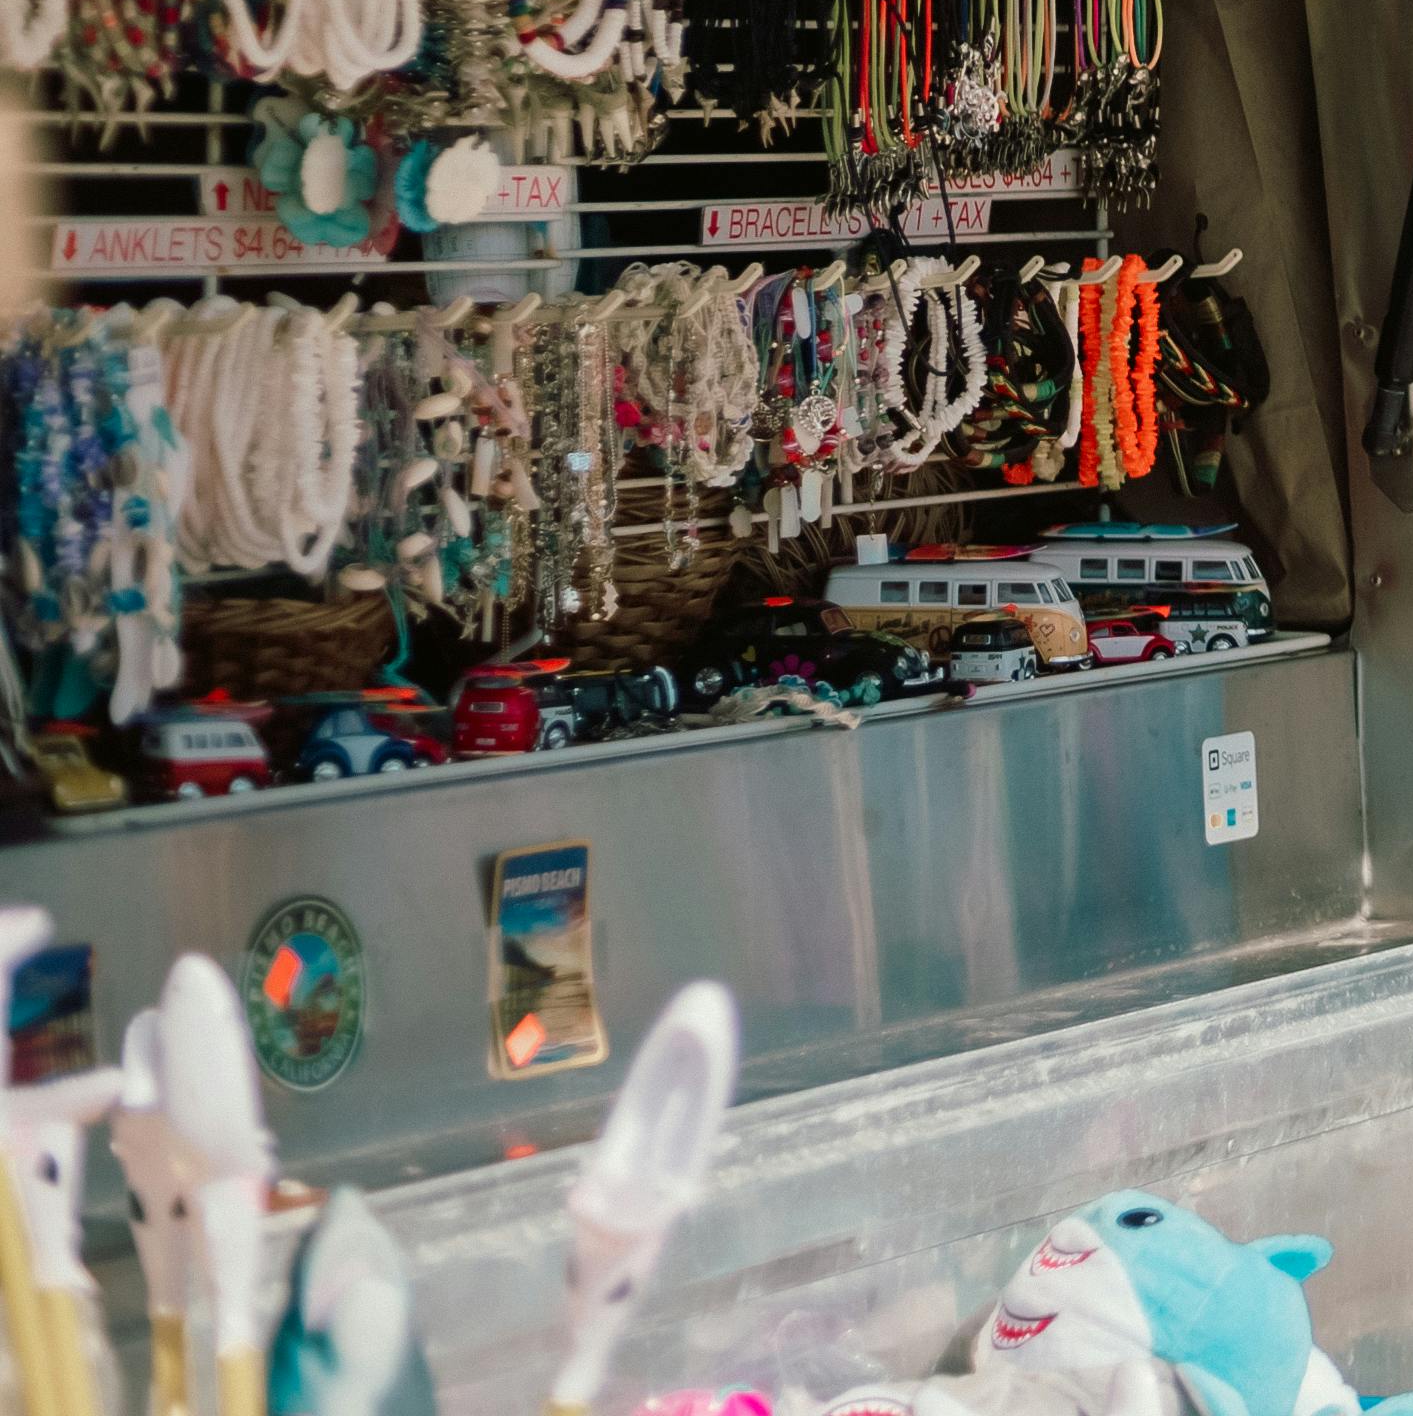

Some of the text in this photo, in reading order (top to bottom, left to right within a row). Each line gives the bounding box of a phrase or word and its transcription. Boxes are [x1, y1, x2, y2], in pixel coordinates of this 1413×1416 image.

[497, 176, 562, 208] +TAX
[90, 226, 223, 262] ANKLETS
[1221, 749, 1250, 768] Square
